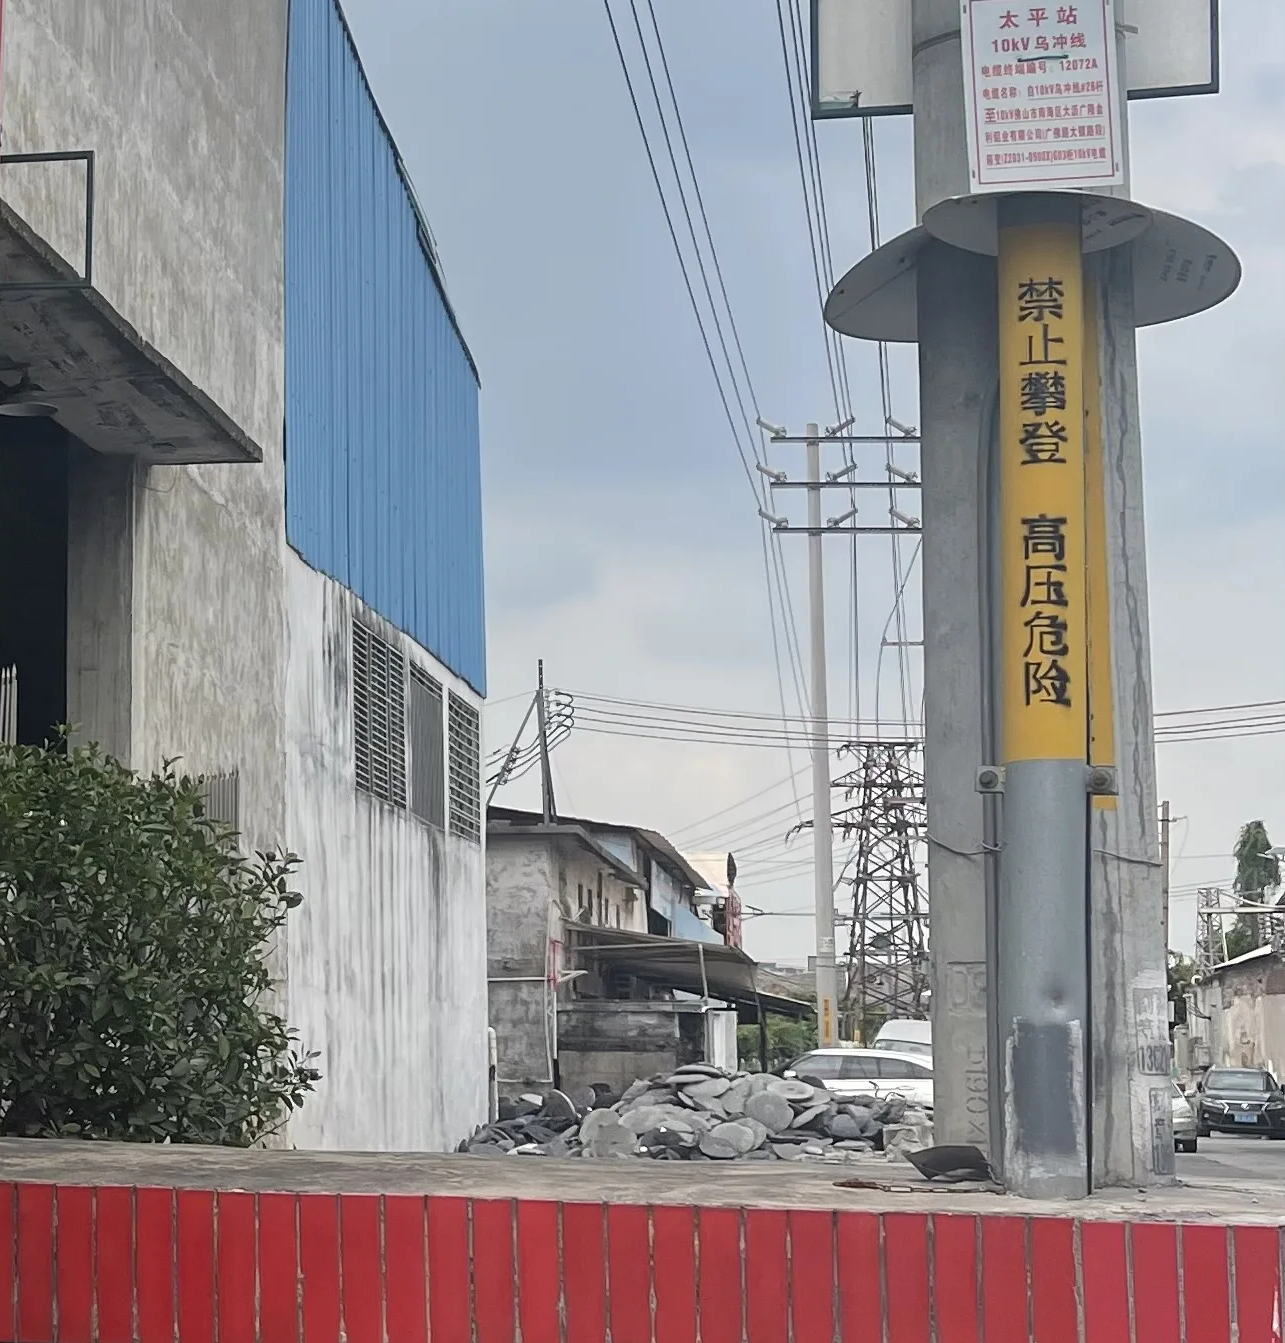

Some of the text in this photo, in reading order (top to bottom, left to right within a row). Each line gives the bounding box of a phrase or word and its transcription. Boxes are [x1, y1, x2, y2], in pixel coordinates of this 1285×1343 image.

[991, 32, 1087, 53] 10kV乌冲线
[999, 5, 1078, 29] 太平站
[1017, 277, 1069, 466] 禁止攀登
[1020, 513, 1072, 709] 高压危险
